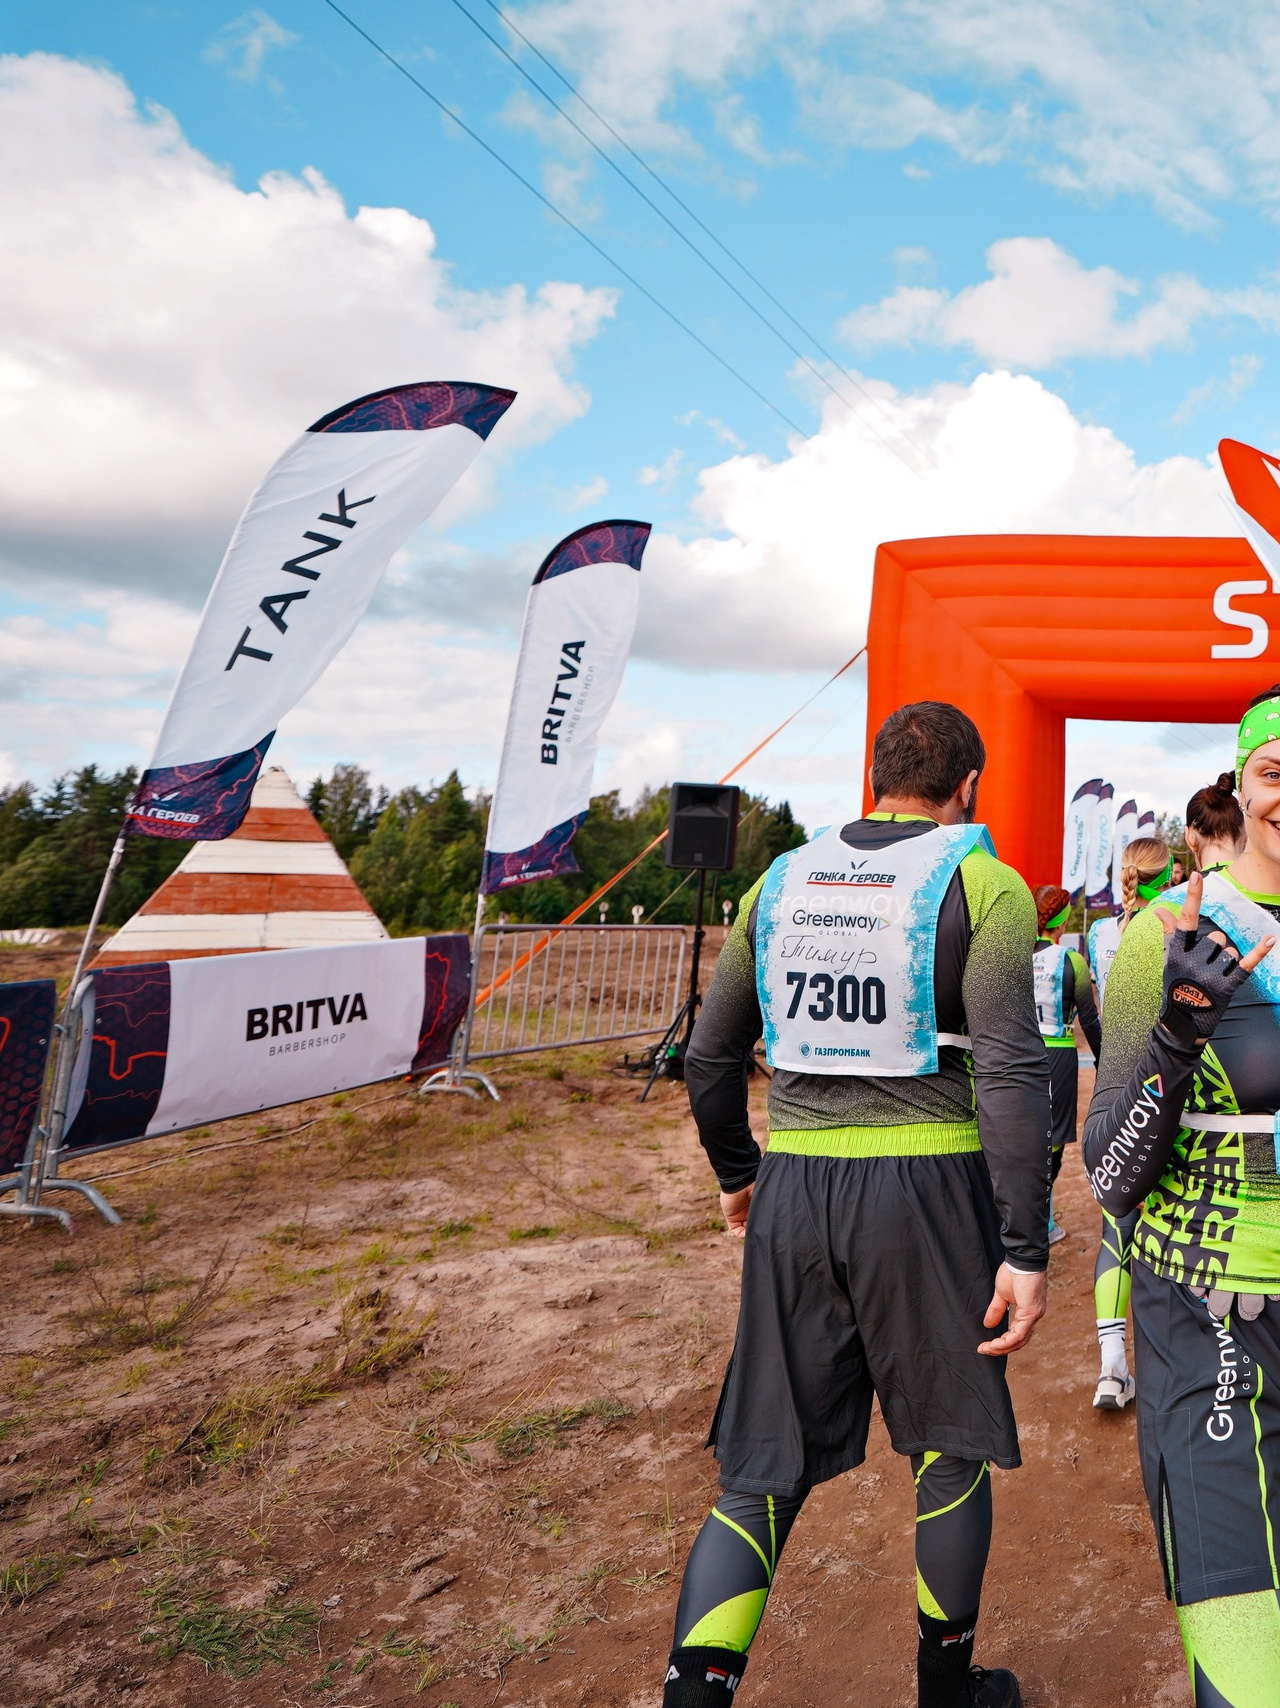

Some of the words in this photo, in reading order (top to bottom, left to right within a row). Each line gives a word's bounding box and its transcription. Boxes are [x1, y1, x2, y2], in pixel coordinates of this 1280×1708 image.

[224, 487, 377, 671] TANK
[540, 640, 586, 765] BRITVA
[565, 665, 596, 743] BARBERSHOP
[147, 807, 200, 824] ГЕРОЕВ
[808, 871, 846, 881] ГОНКА
[849, 873, 897, 884] ГЕРОЕВ
[792, 909, 878, 933] Greenway
[245, 992, 368, 1042] BRITVA
[786, 971, 887, 1025] 7300
[269, 1033, 347, 1056] BARBERSHOP
[814, 1046, 871, 1058] ГАЗПРОМБАНК
[1121, 1133, 1158, 1194] GLOBAL
